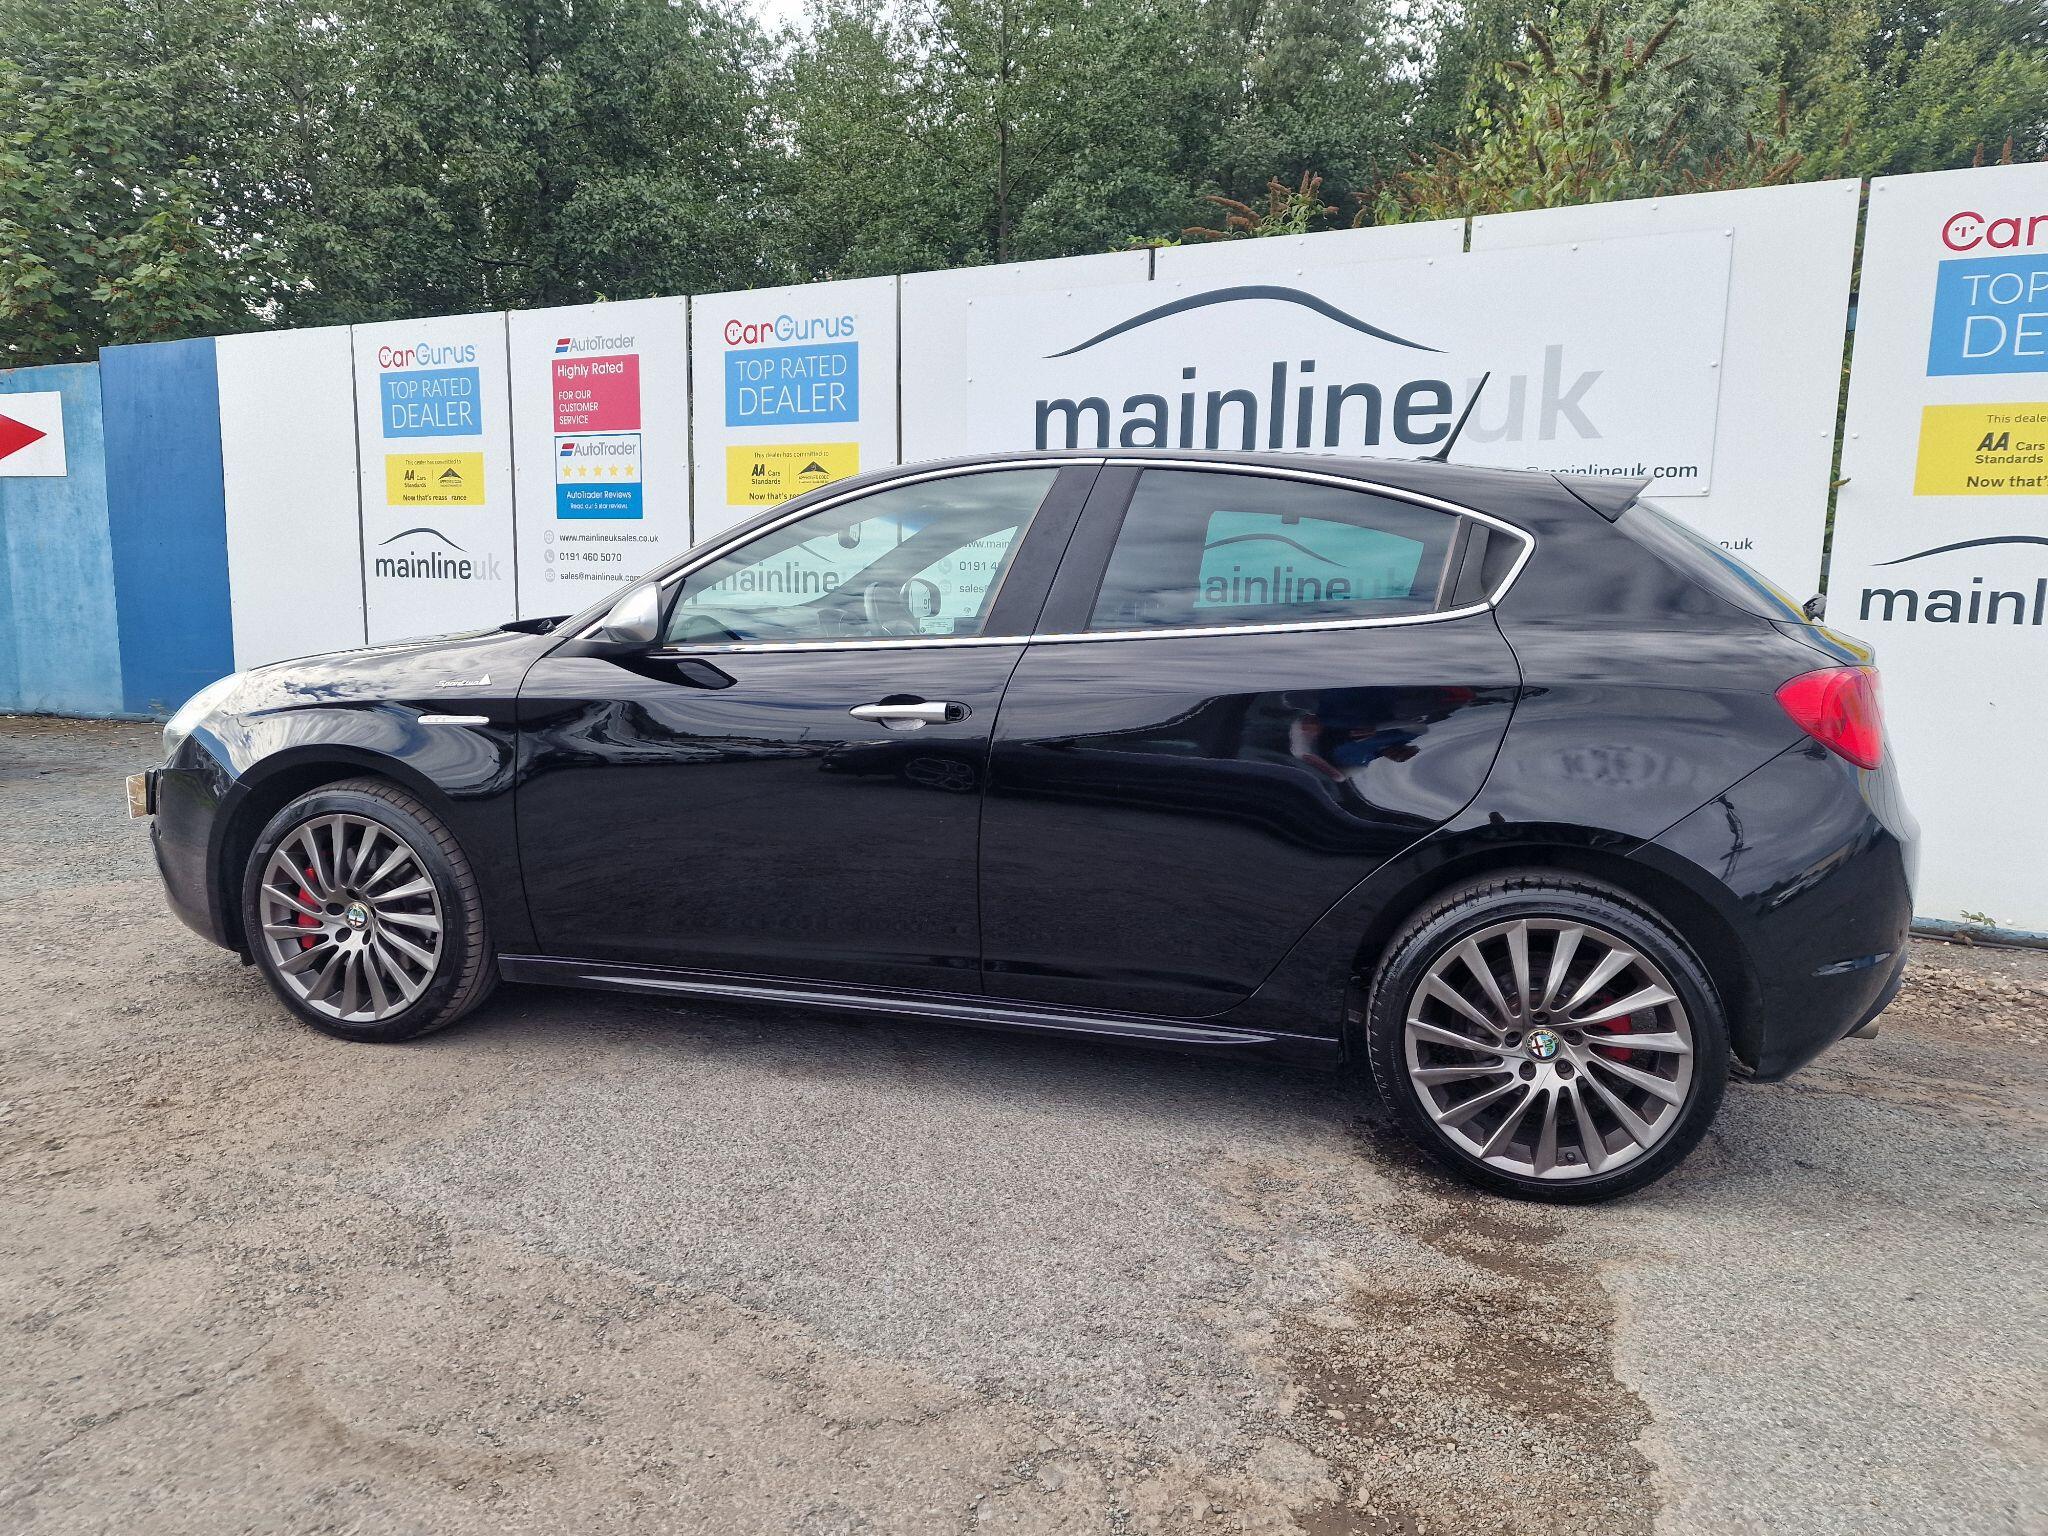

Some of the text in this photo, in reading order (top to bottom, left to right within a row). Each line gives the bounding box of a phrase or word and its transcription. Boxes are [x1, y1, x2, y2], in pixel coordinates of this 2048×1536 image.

[1962, 270, 2048, 306] TOP
[724, 314, 855, 346] CarGurus
[569, 333, 635, 352] AutoTrader
[378, 342, 476, 368] CarGurus
[557, 361, 624, 379] Highly Rated
[735, 354, 847, 381] TOP RATED
[388, 378, 472, 400] TOP RATED
[558, 389, 592, 400] FOR OUR
[559, 402, 599, 412] CUSTOMER
[739, 382, 847, 416] DEALER
[392, 401, 473, 429] DEALER
[559, 415, 589, 425] SERVICE
[1987, 413, 2048, 423] This deale
[574, 441, 636, 457] AutoTrader
[1976, 431, 2046, 451] AA Cars
[1975, 453, 2044, 464] Standards
[751, 463, 766, 476] AA
[1966, 475, 2006, 488] Now
[566, 490, 632, 499] AutoTrader Reviews
[749, 492, 766, 500] Now
[767, 492, 788, 500] that's
[559, 552, 622, 562] 0191 460 5070
[375, 551, 502, 581] mainlineuk
[959, 561, 987, 571] 0191
